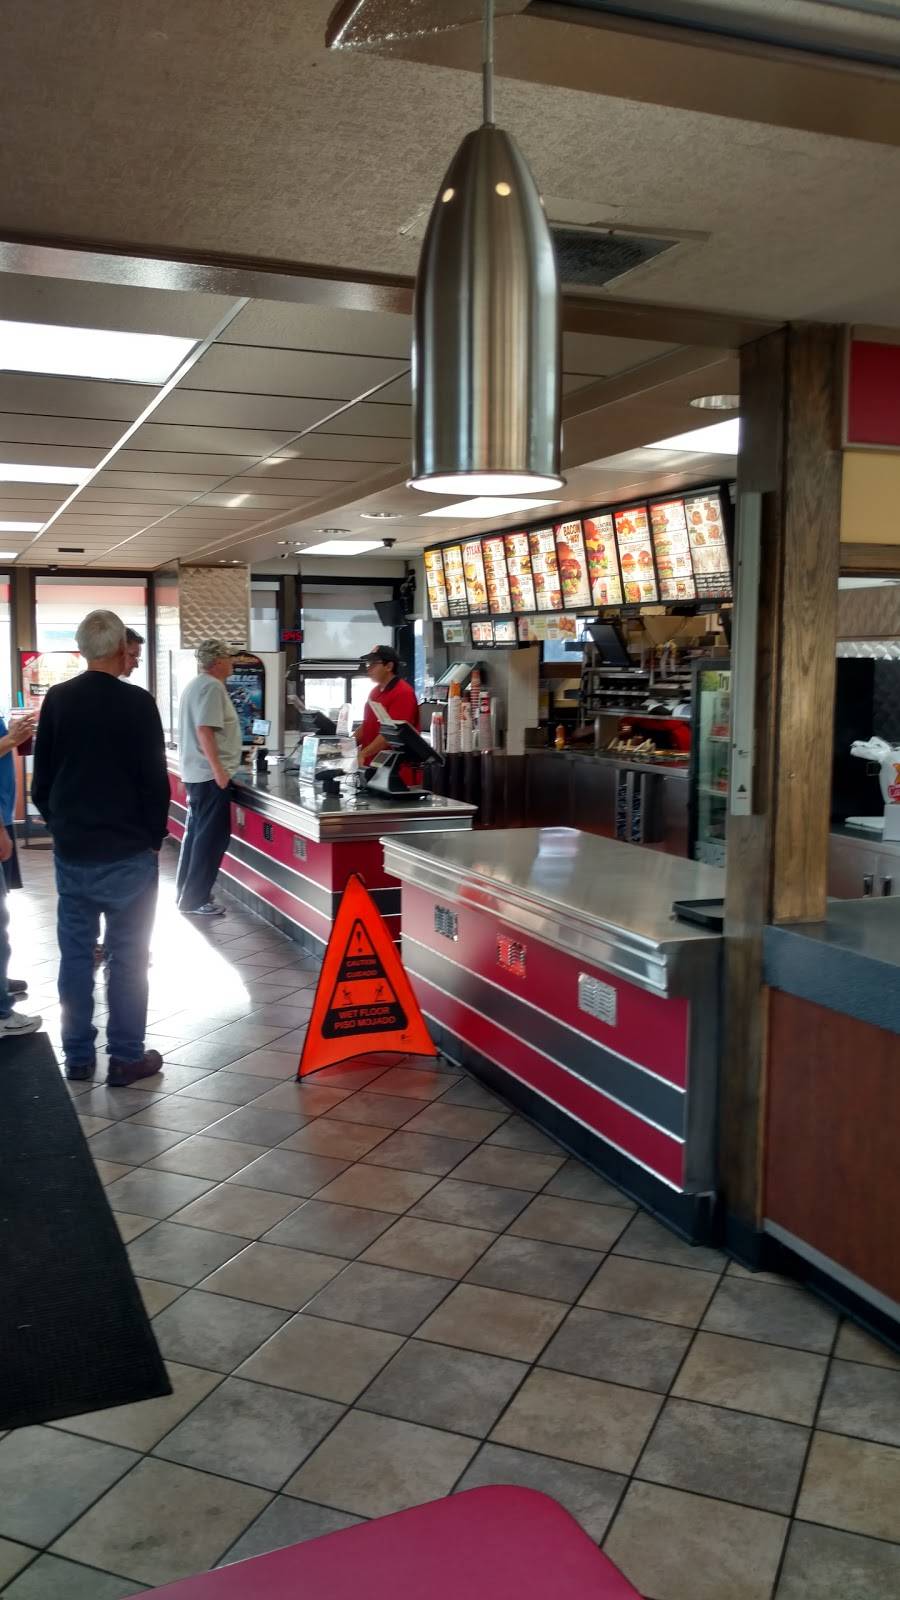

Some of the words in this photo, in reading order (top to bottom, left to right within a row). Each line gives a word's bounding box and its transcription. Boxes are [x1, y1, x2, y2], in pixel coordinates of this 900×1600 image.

[563, 522, 580, 536] BACON
[347, 958, 377, 967] CAUTION
[346, 970, 378, 978] CUIDADO
[338, 1010, 358, 1018] WET
[359, 1007, 390, 1016] FLOOR
[334, 1020, 356, 1030] PISO
[358, 1016, 395, 1026] MOJADO
